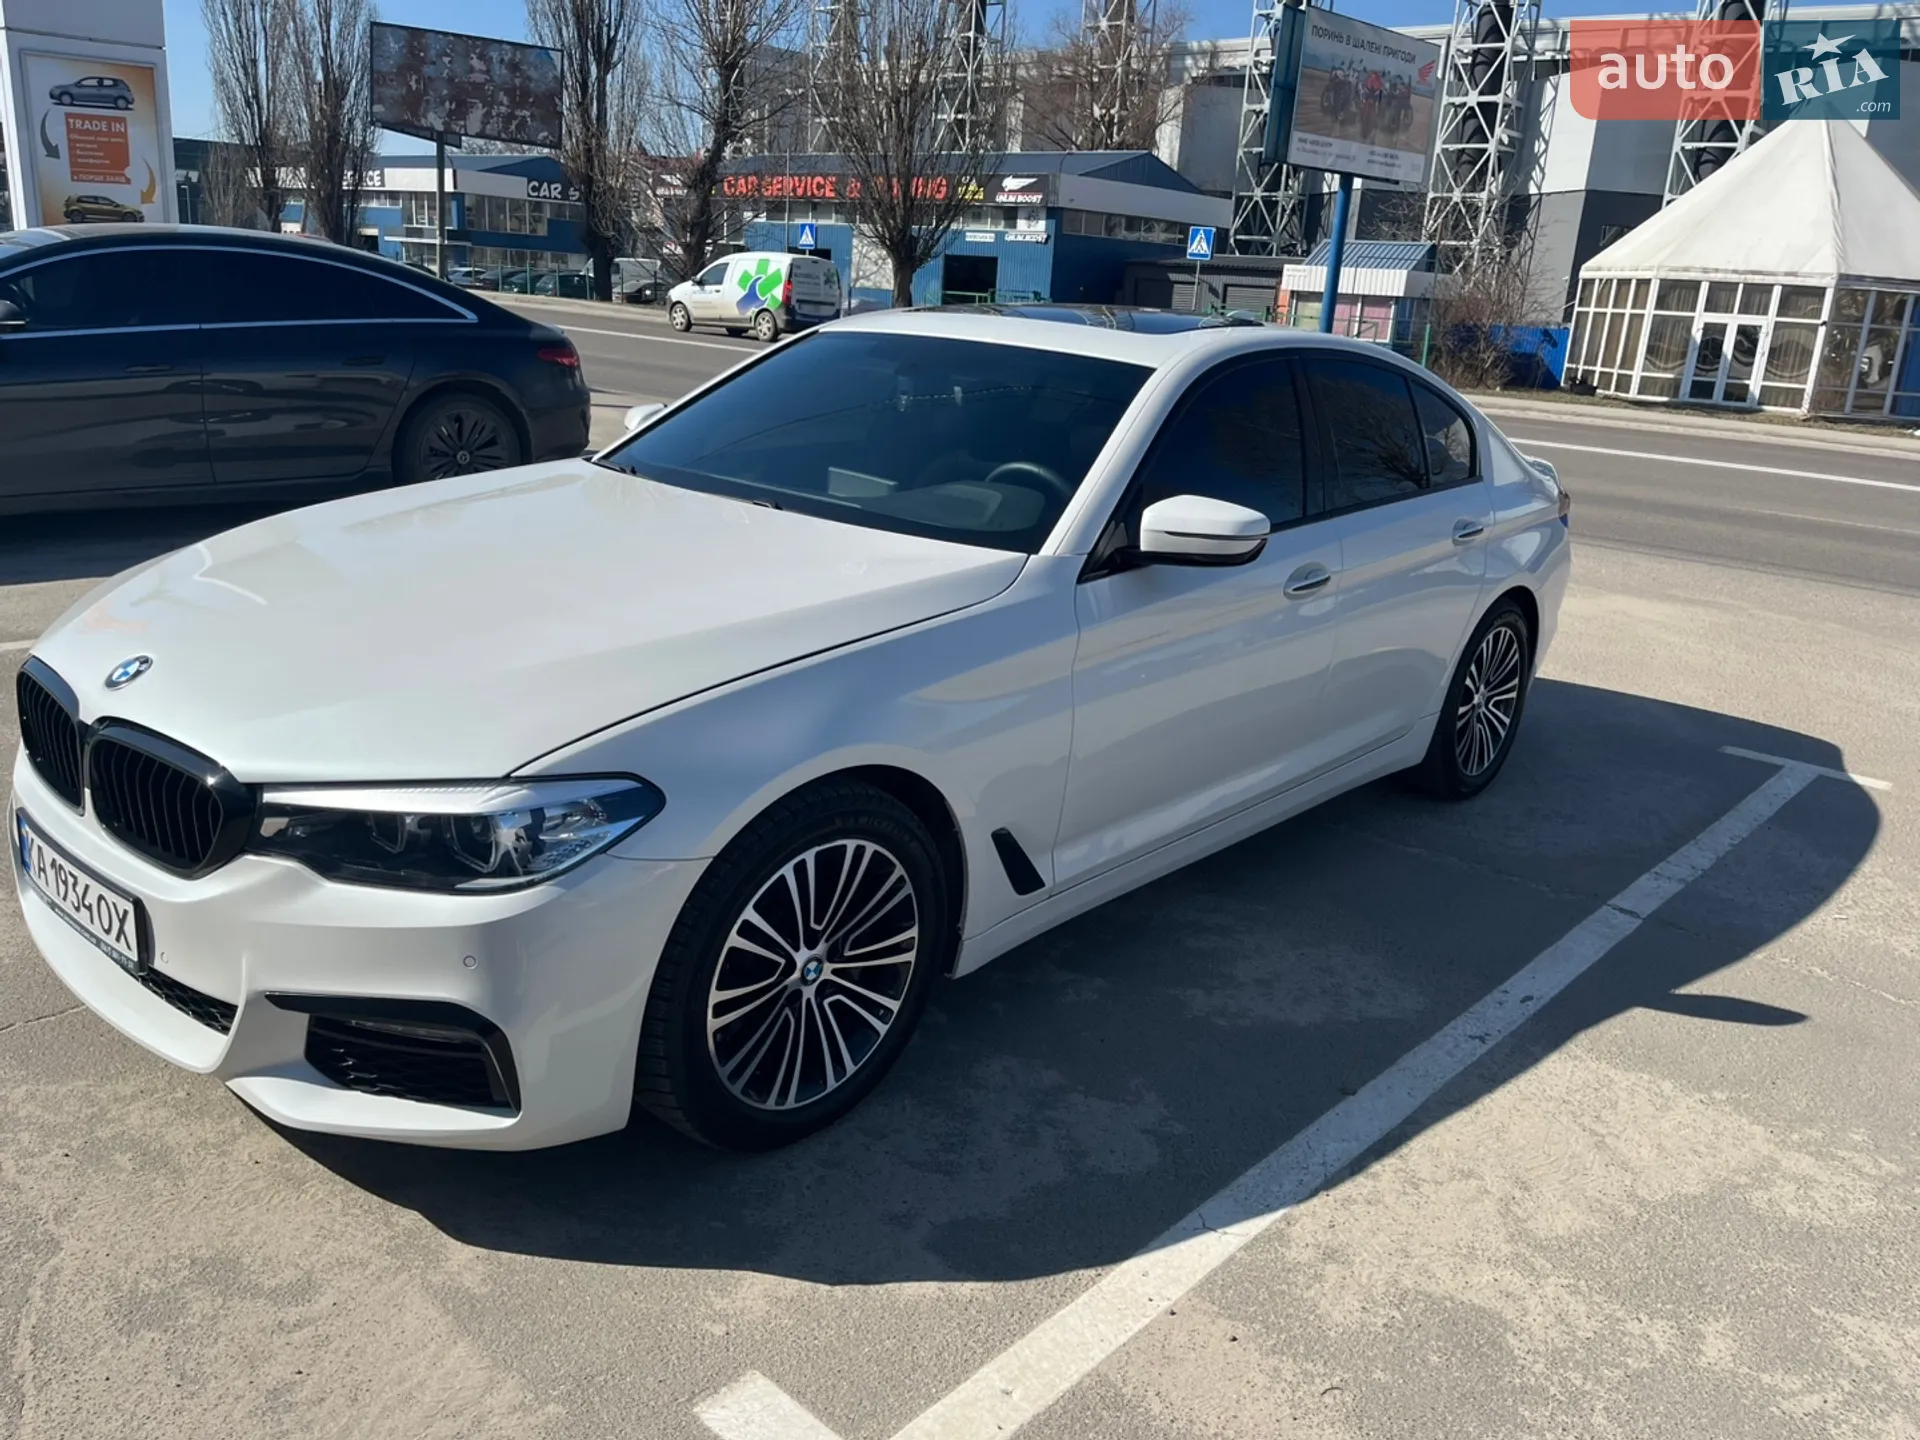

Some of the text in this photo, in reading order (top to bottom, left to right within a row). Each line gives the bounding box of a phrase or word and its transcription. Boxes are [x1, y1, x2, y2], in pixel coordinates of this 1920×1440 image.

[1311, 25, 1344, 45] ПОРИНЬ
[1352, 36, 1382, 55] ШАЛЕНІ
[1383, 45, 1417, 65] ПРИГОДИ
[67, 118, 125, 133] TRADE IN
[528, 180, 562, 200] CAR
[762, 175, 836, 198] SERVICE
[1018, 193, 1044, 204] BOOST
[51, 857, 95, 926] 1934
